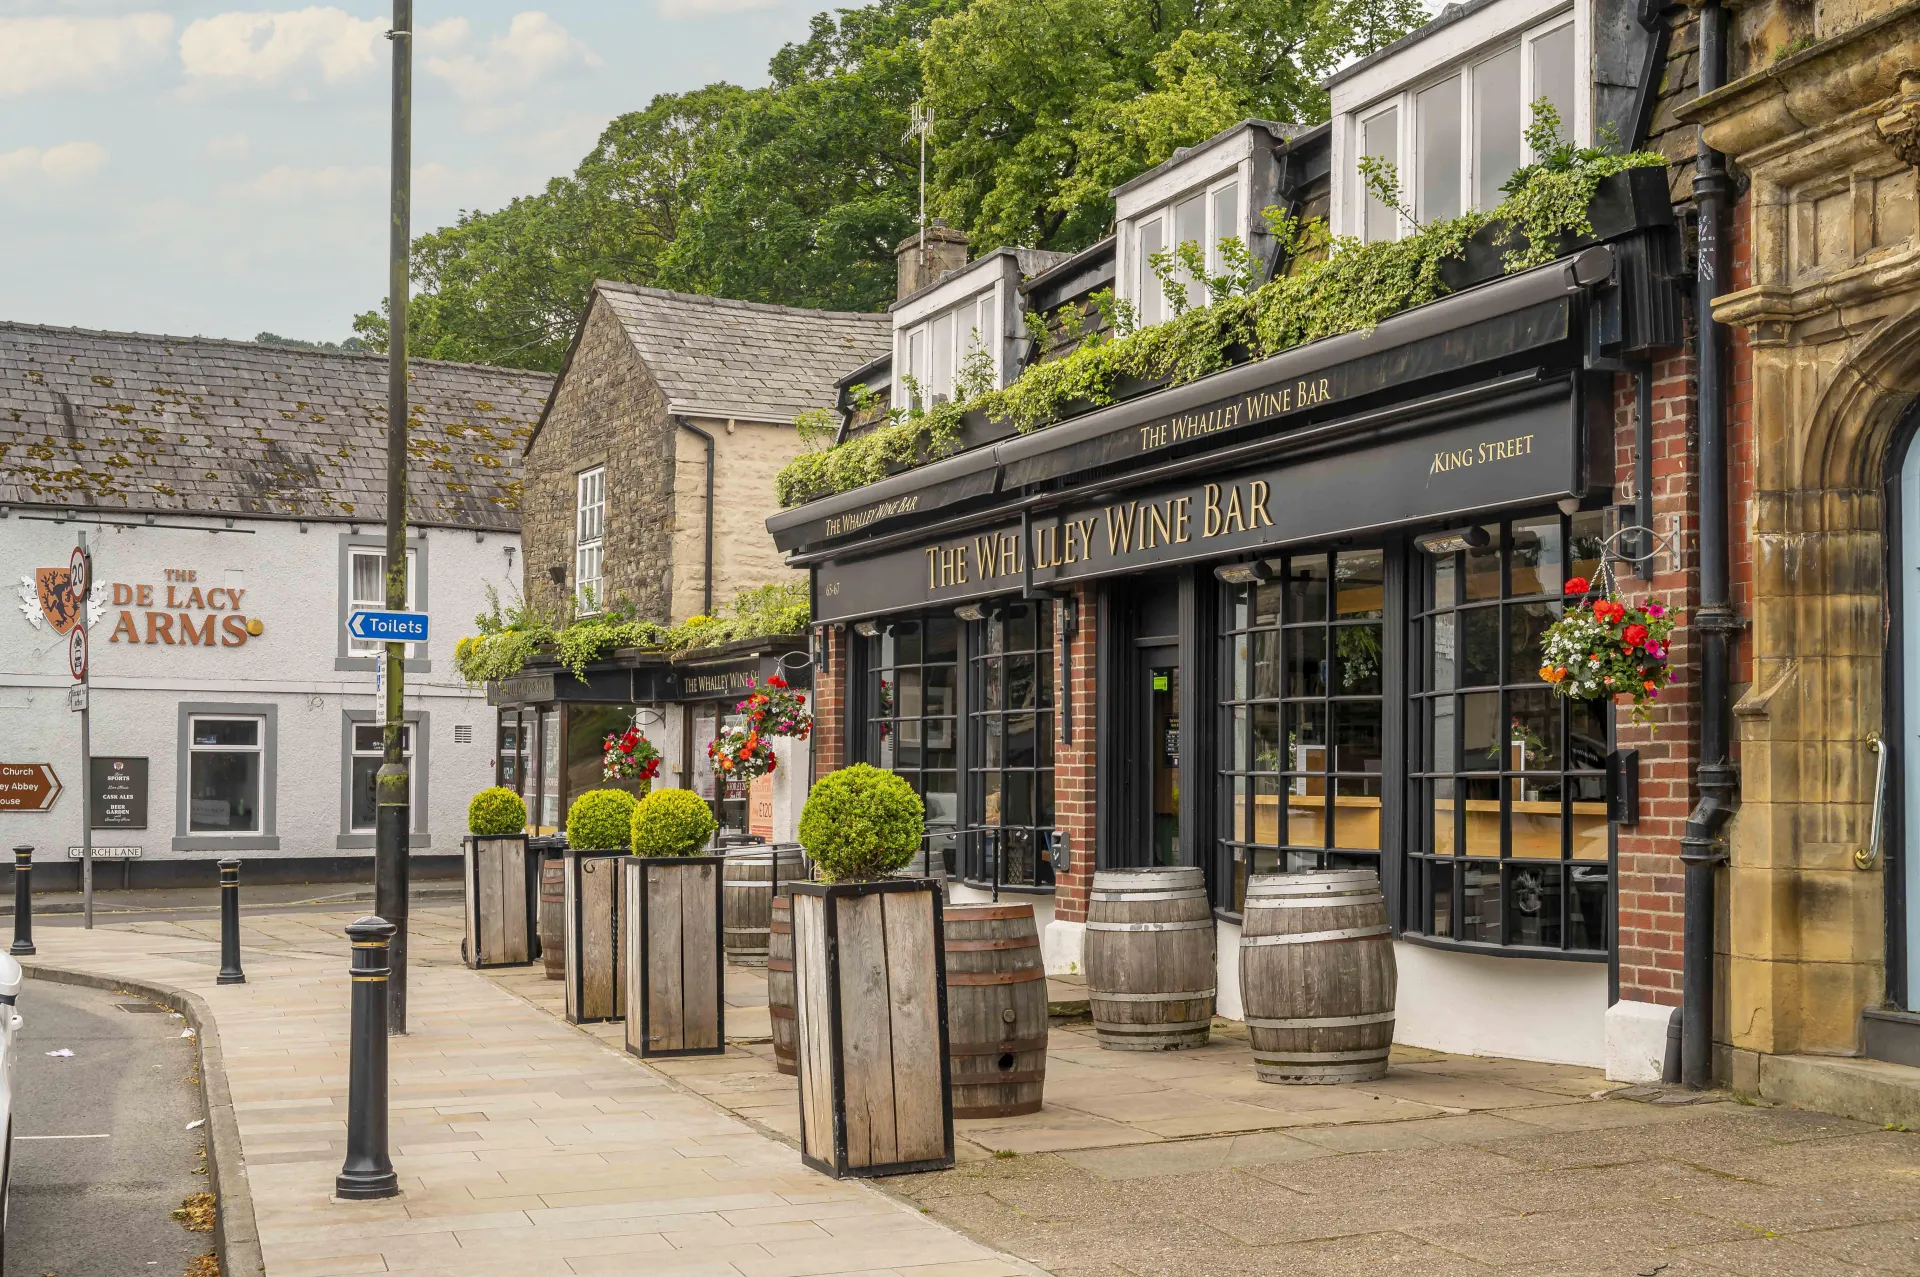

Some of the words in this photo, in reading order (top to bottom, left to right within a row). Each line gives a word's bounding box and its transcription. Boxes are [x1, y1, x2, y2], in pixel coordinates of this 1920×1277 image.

[1140, 424, 1167, 450] THE
[1171, 402, 1243, 442] WHALLEY
[1246, 388, 1291, 421] WINE
[1297, 378, 1331, 408] BAR
[1434, 448, 1473, 474] KING
[1478, 434, 1534, 464] STREET
[825, 518, 841, 537] THE
[842, 507, 878, 532] WHALLEY
[875, 500, 900, 519] WINE
[896, 495, 918, 514] BAR
[925, 545, 969, 590] THE
[1104, 496, 1192, 556] WINE
[1202, 480, 1277, 538] BAR
[72, 563, 84, 587] 20
[164, 568, 197, 582] THE
[112, 582, 154, 606] DE
[166, 585, 246, 610] LACY
[108, 610, 248, 647] ARMS
[369, 618, 423, 634] Toilets
[684, 677, 698, 693] THE
[698, 674, 729, 692] WHALLEY
[729, 671, 748, 689] WINE
[750, 669, 760, 687] SH
[2, 767, 34, 776] Church
[0, 784, 10, 792] ey
[11, 782, 39, 792] Abbey
[71, 848, 111, 856] CHRCH
[114, 848, 140, 856] LANE
